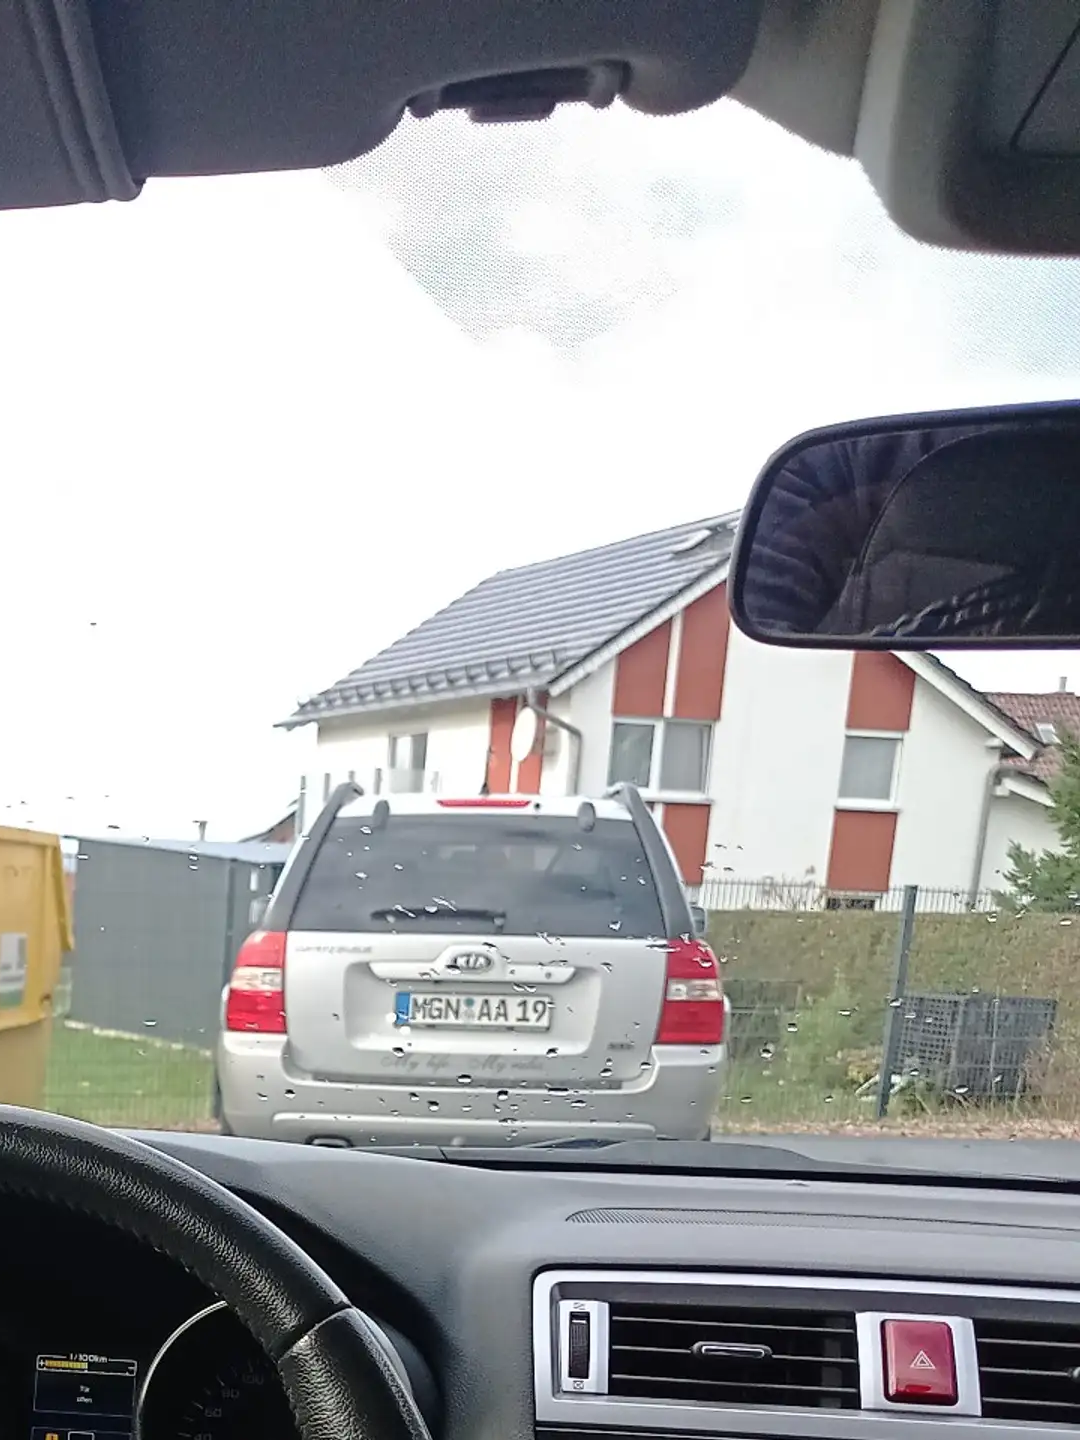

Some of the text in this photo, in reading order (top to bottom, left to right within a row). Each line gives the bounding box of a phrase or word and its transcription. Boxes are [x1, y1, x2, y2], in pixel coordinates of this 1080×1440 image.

[455, 953, 488, 968] KIA
[412, 997, 547, 1022] MGN AA 19
[204, 1408, 222, 1418] 60
